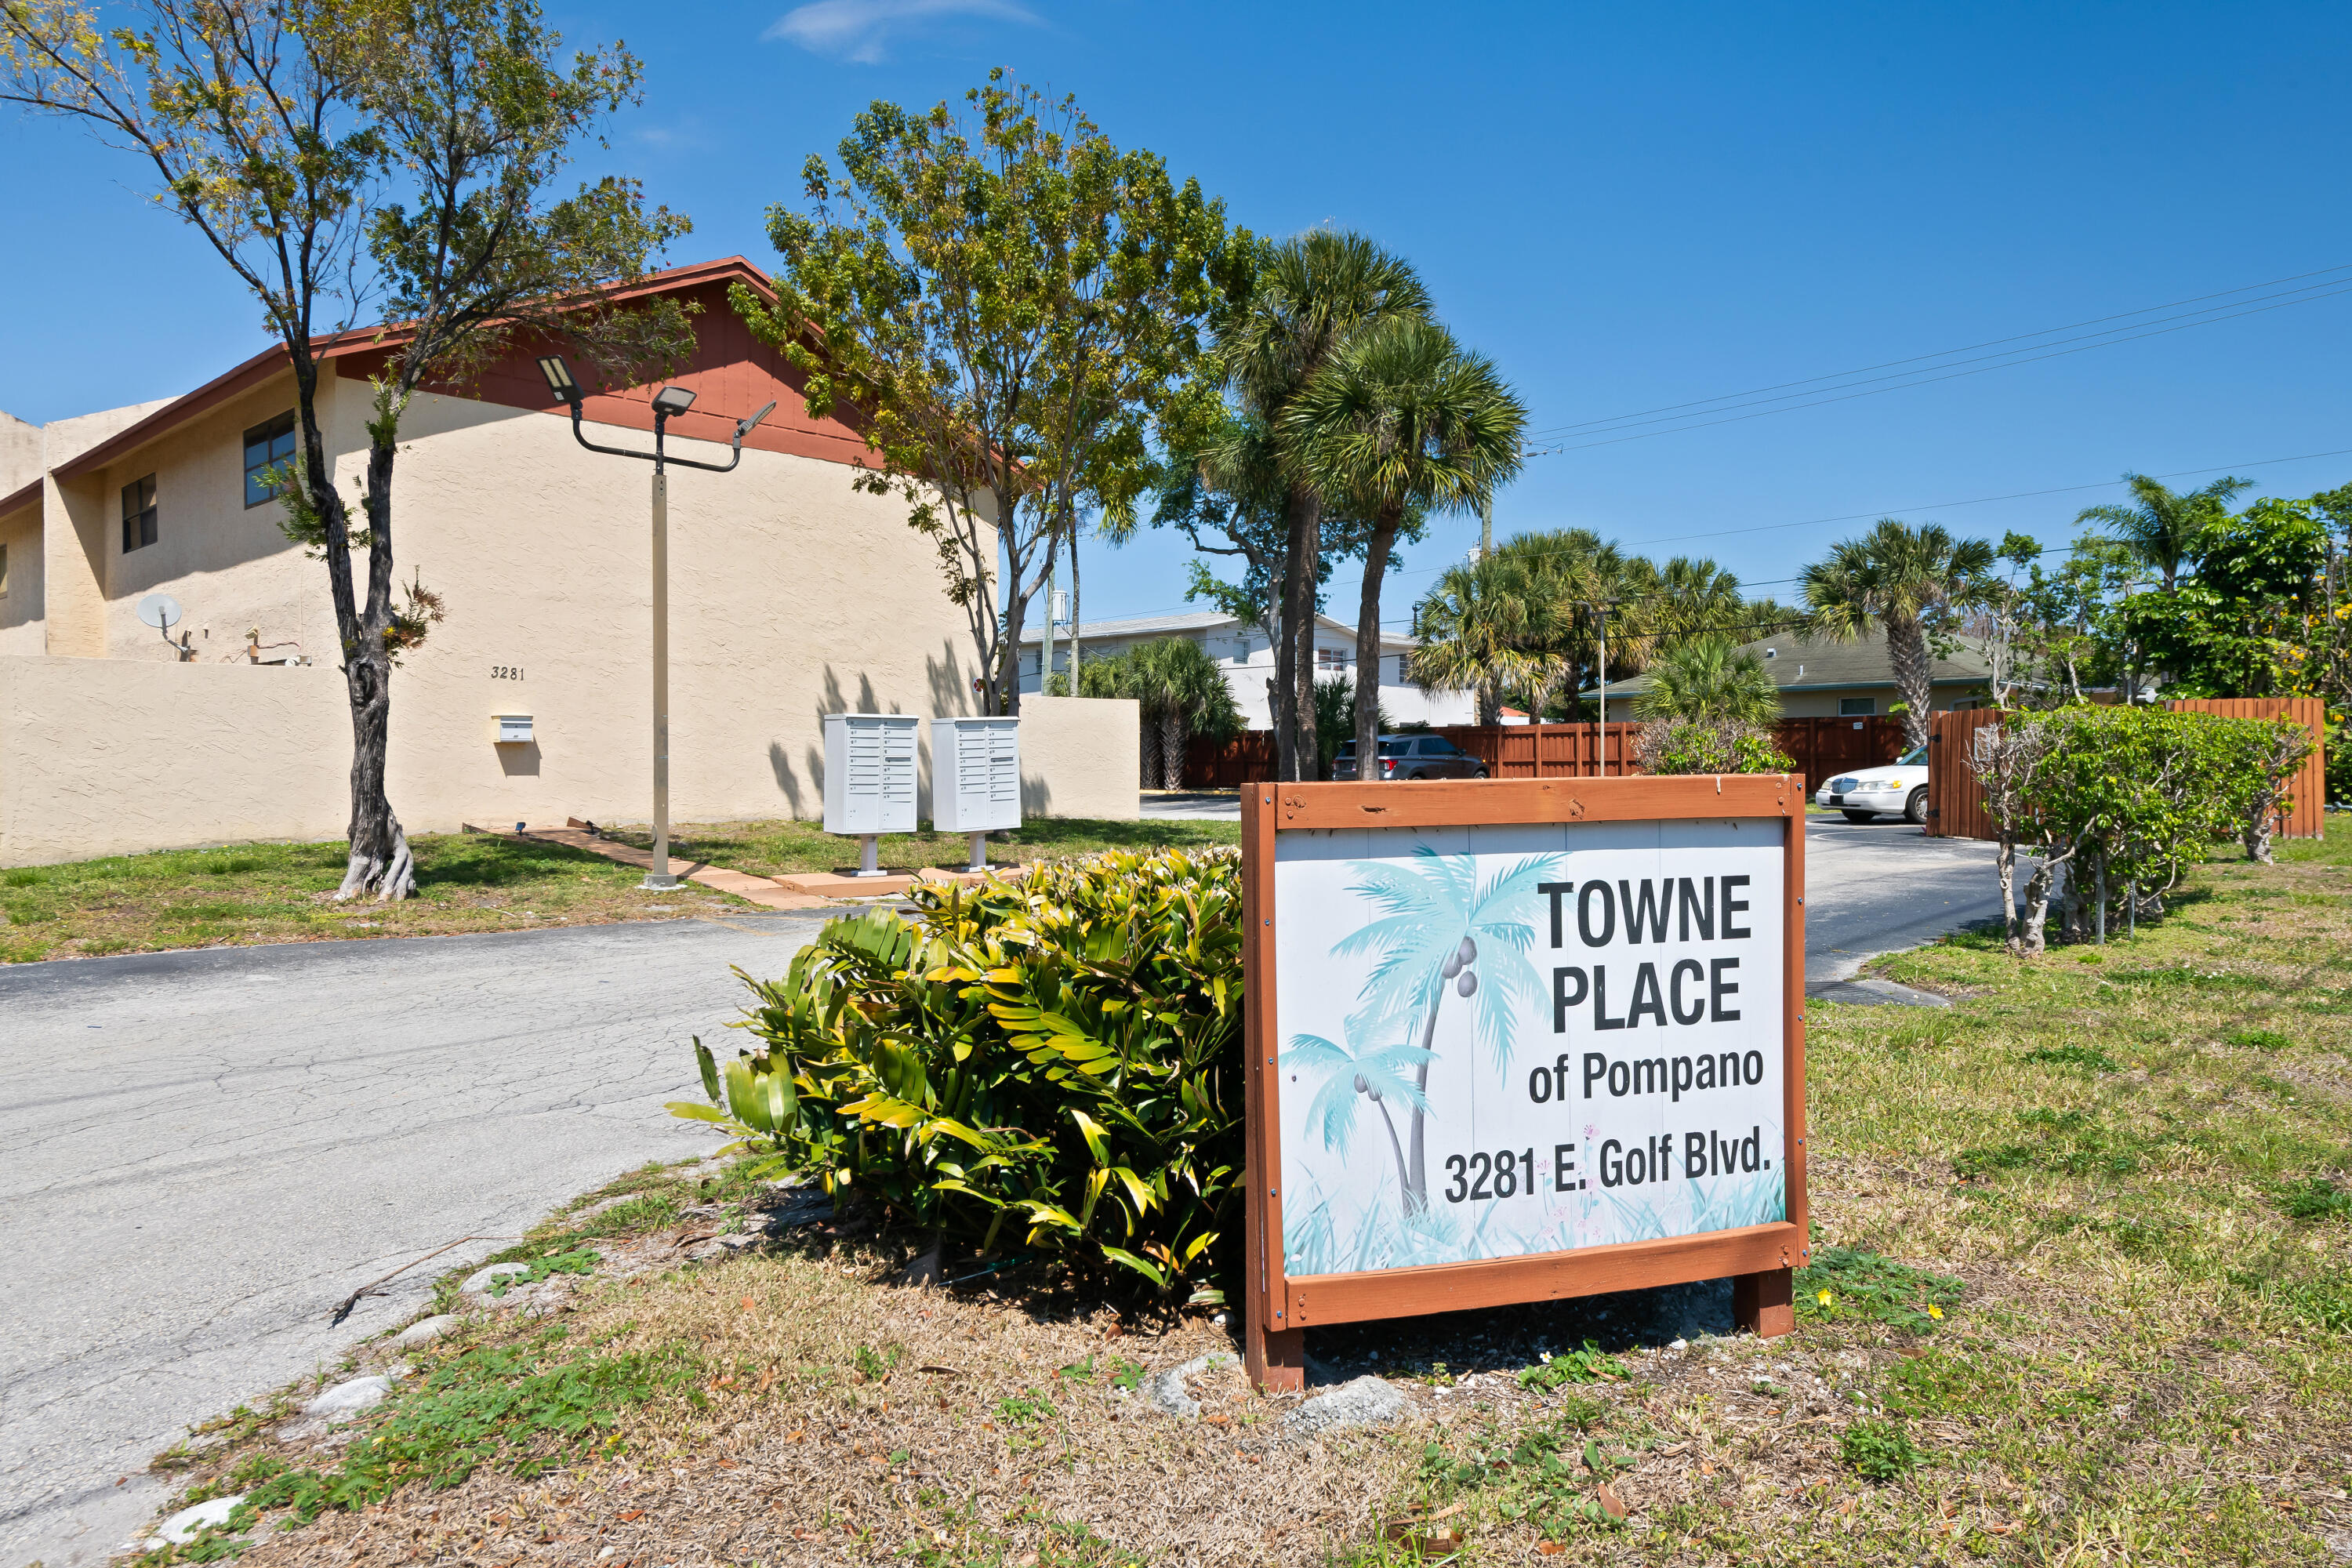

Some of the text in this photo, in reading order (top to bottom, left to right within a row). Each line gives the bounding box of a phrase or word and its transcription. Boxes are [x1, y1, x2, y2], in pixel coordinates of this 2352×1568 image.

[491, 666, 524, 681] 3281
[1537, 874, 1752, 949] TOWNE
[1552, 957, 1741, 1034] PLACE
[1528, 1049, 1764, 1104] of Pompano
[1444, 1126, 1771, 1204] 3281 E. Golf Blvd.
